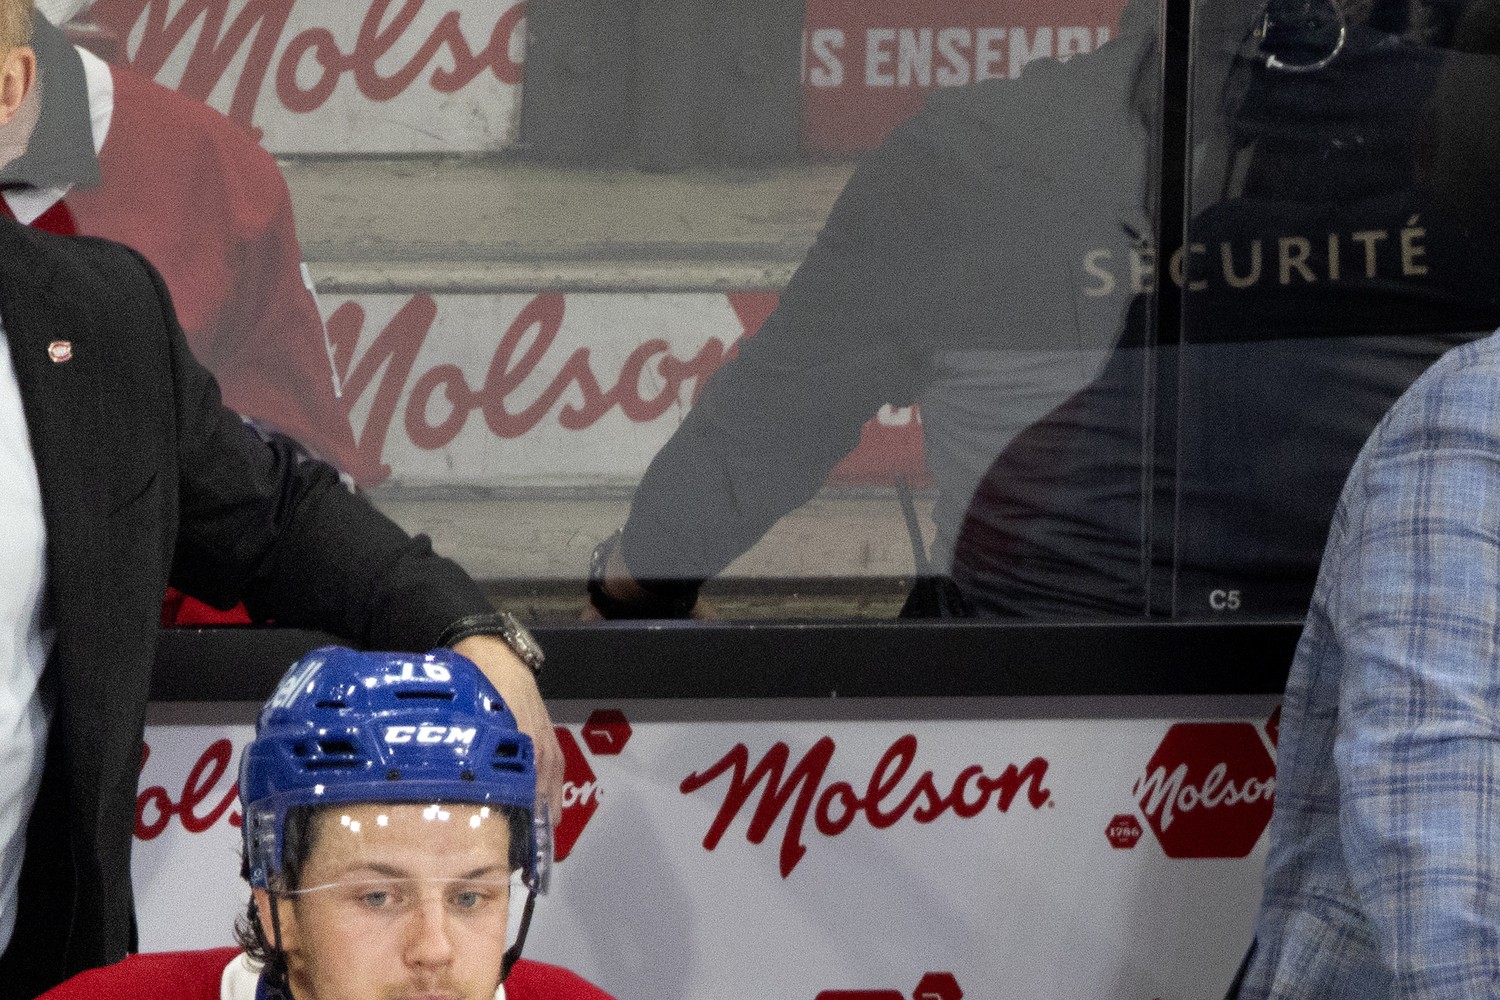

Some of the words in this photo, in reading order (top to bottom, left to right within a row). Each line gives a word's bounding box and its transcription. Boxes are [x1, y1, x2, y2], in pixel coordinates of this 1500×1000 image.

[801, 28, 845, 87] S
[866, 27, 1110, 87] ENSEM
[1209, 589, 1241, 610] C5
[384, 725, 478, 744] CCM
[680, 734, 1051, 879] Molson
